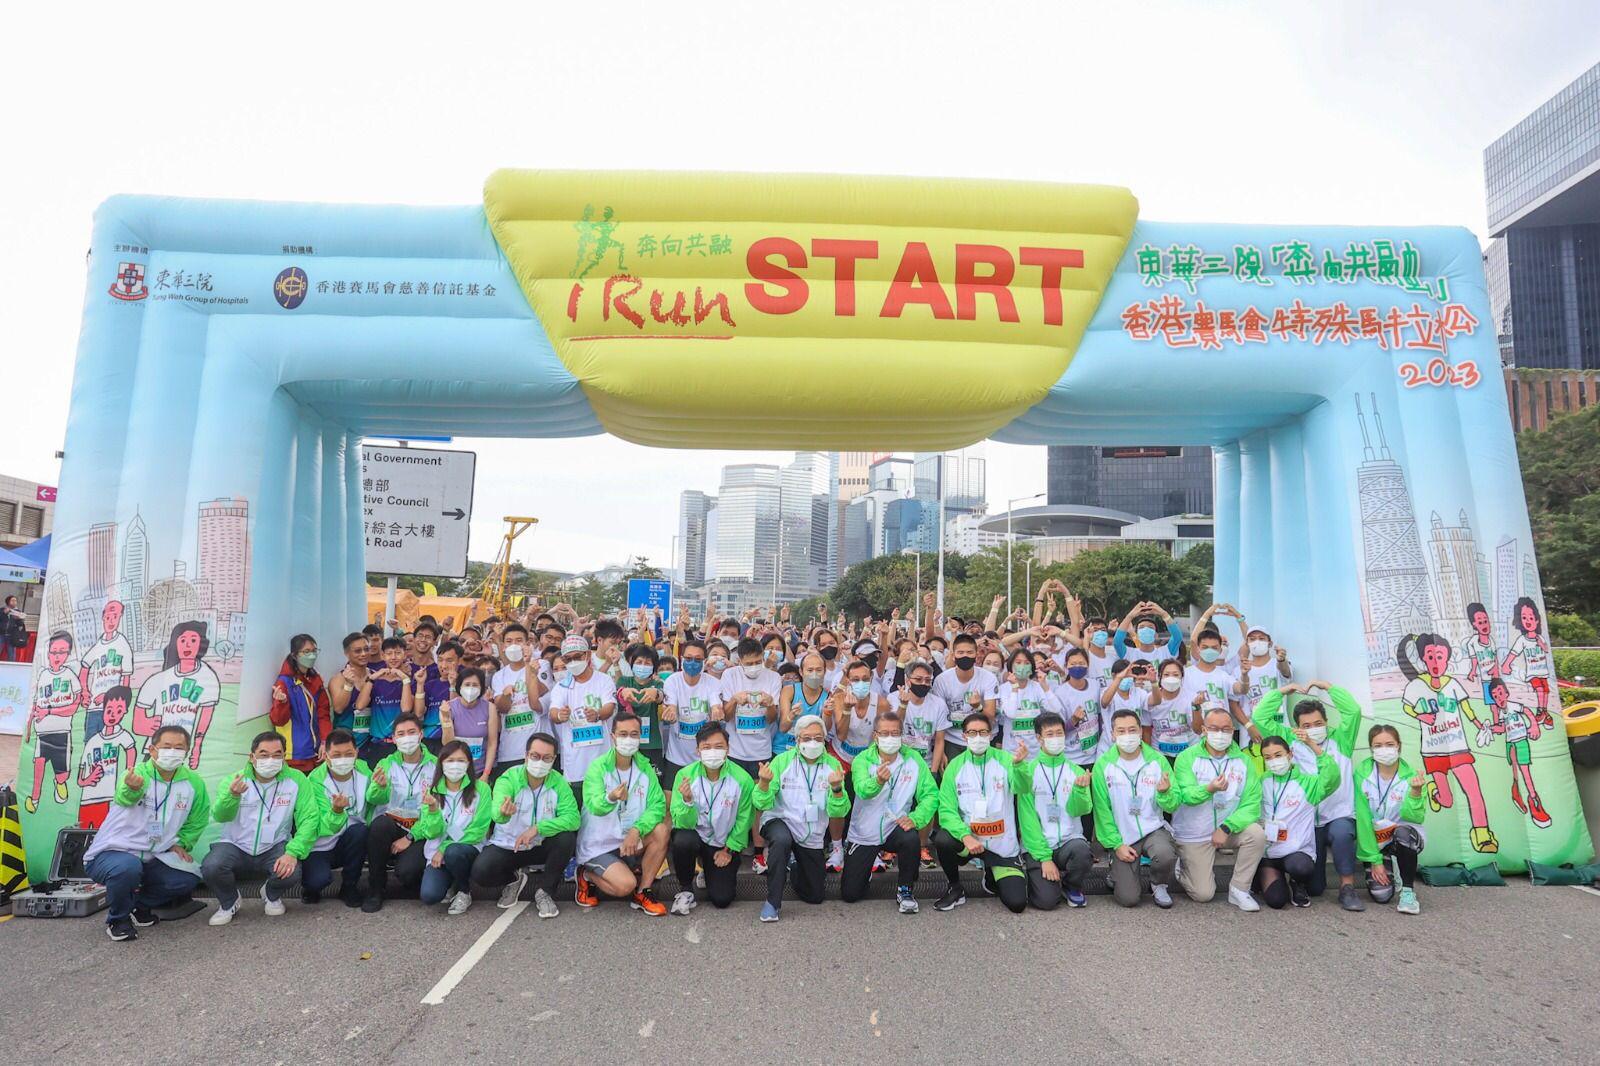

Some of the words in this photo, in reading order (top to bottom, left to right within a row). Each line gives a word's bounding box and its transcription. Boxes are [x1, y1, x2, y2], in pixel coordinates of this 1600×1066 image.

[636, 233, 732, 259] 奔向共融
[154, 269, 214, 291] 東華三院
[745, 236, 1084, 326] START
[315, 280, 498, 298] 香港賽馬會慈善信託基金
[184, 294, 209, 304] Group
[217, 296, 249, 305] Hospitals
[1400, 358, 1481, 388] 2023
[374, 452, 442, 466] Government
[387, 495, 430, 508] Council
[374, 537, 403, 548] Road
[505, 713, 533, 726] M1040
[572, 727, 602, 739] M1314
[973, 823, 1002, 833] V0001
